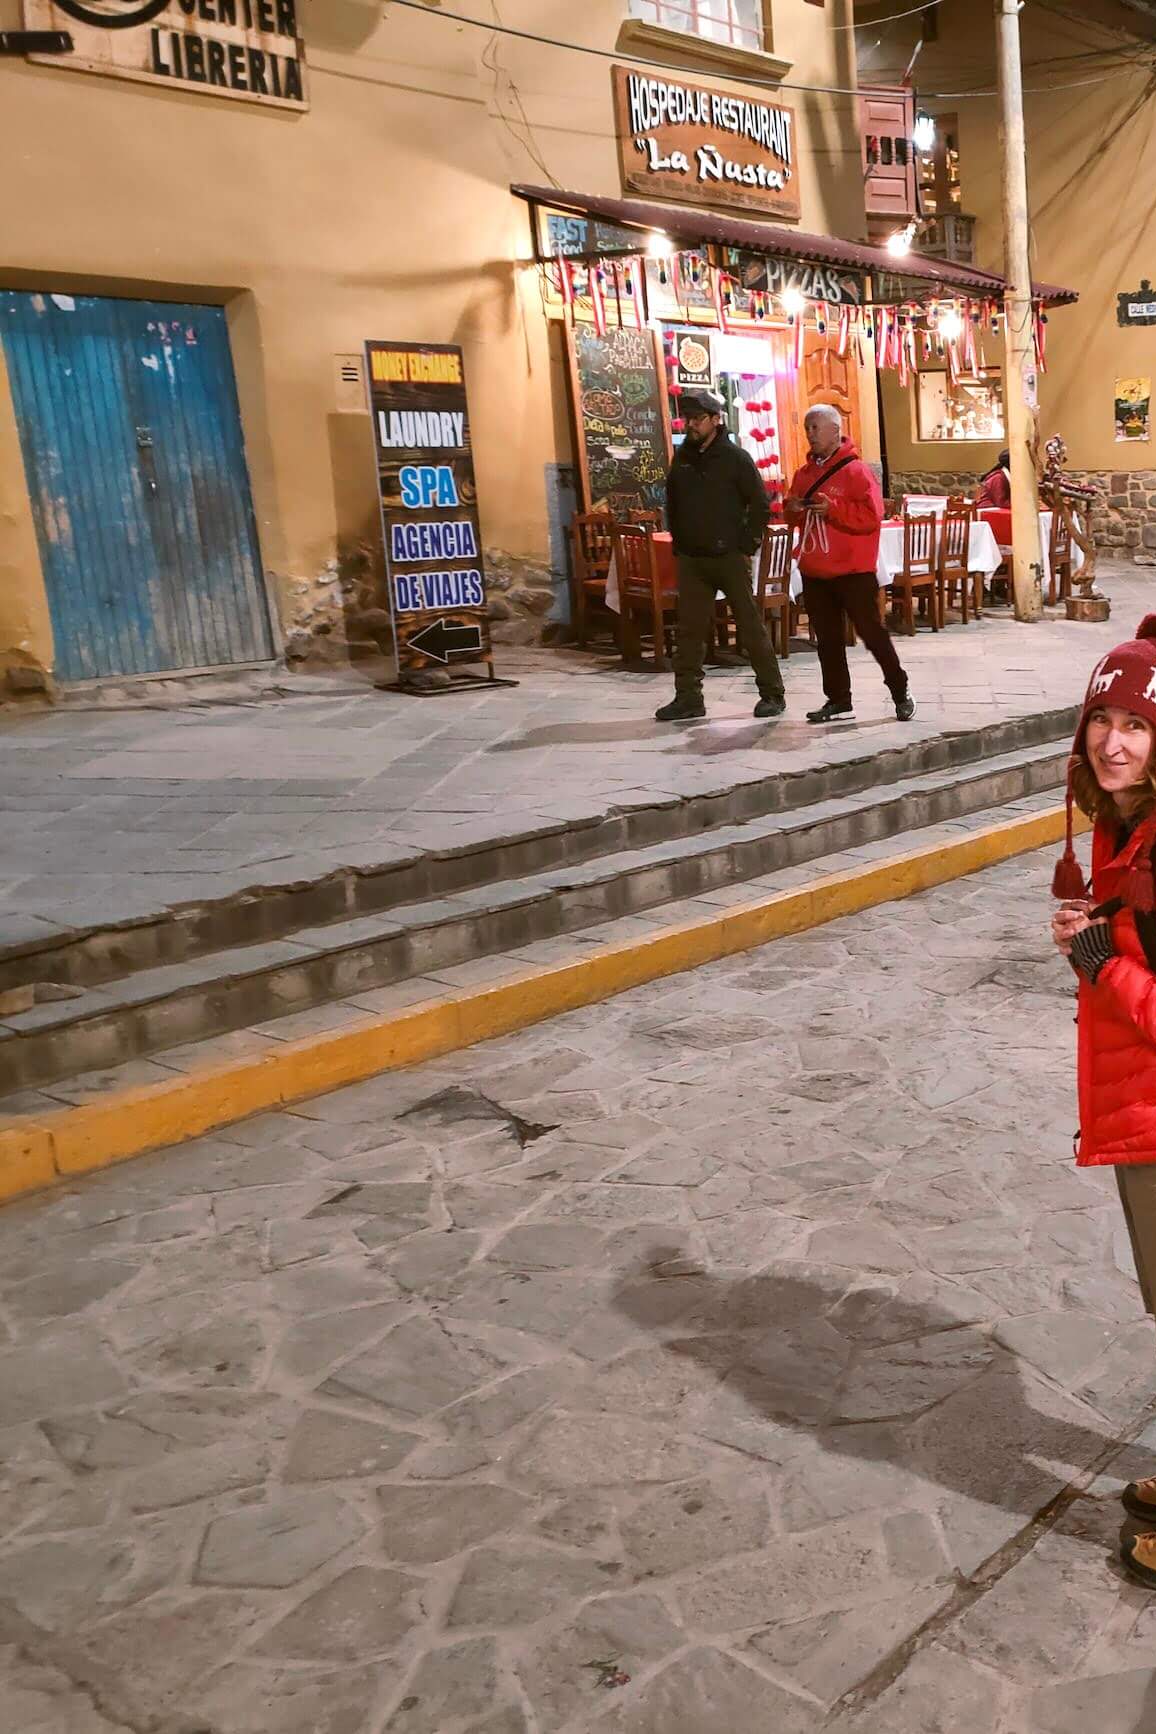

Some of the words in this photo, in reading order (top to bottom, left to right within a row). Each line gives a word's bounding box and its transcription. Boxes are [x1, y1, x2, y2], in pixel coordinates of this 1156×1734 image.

[151, 27, 303, 101] LIBRERIA
[628, 73, 711, 135] HOSPEDAJE
[710, 94, 792, 165] RESTAURANT
[547, 216, 588, 242] FAST
[765, 257, 842, 303] PIZZAS
[370, 350, 408, 381] MONEY
[679, 372, 710, 383] PIZZA
[378, 410, 464, 448] LAUNDRY
[399, 465, 459, 509] SPA
[391, 521, 477, 562] AGENCIA
[394, 573, 422, 612] DE
[420, 569, 483, 609] VIAJES
